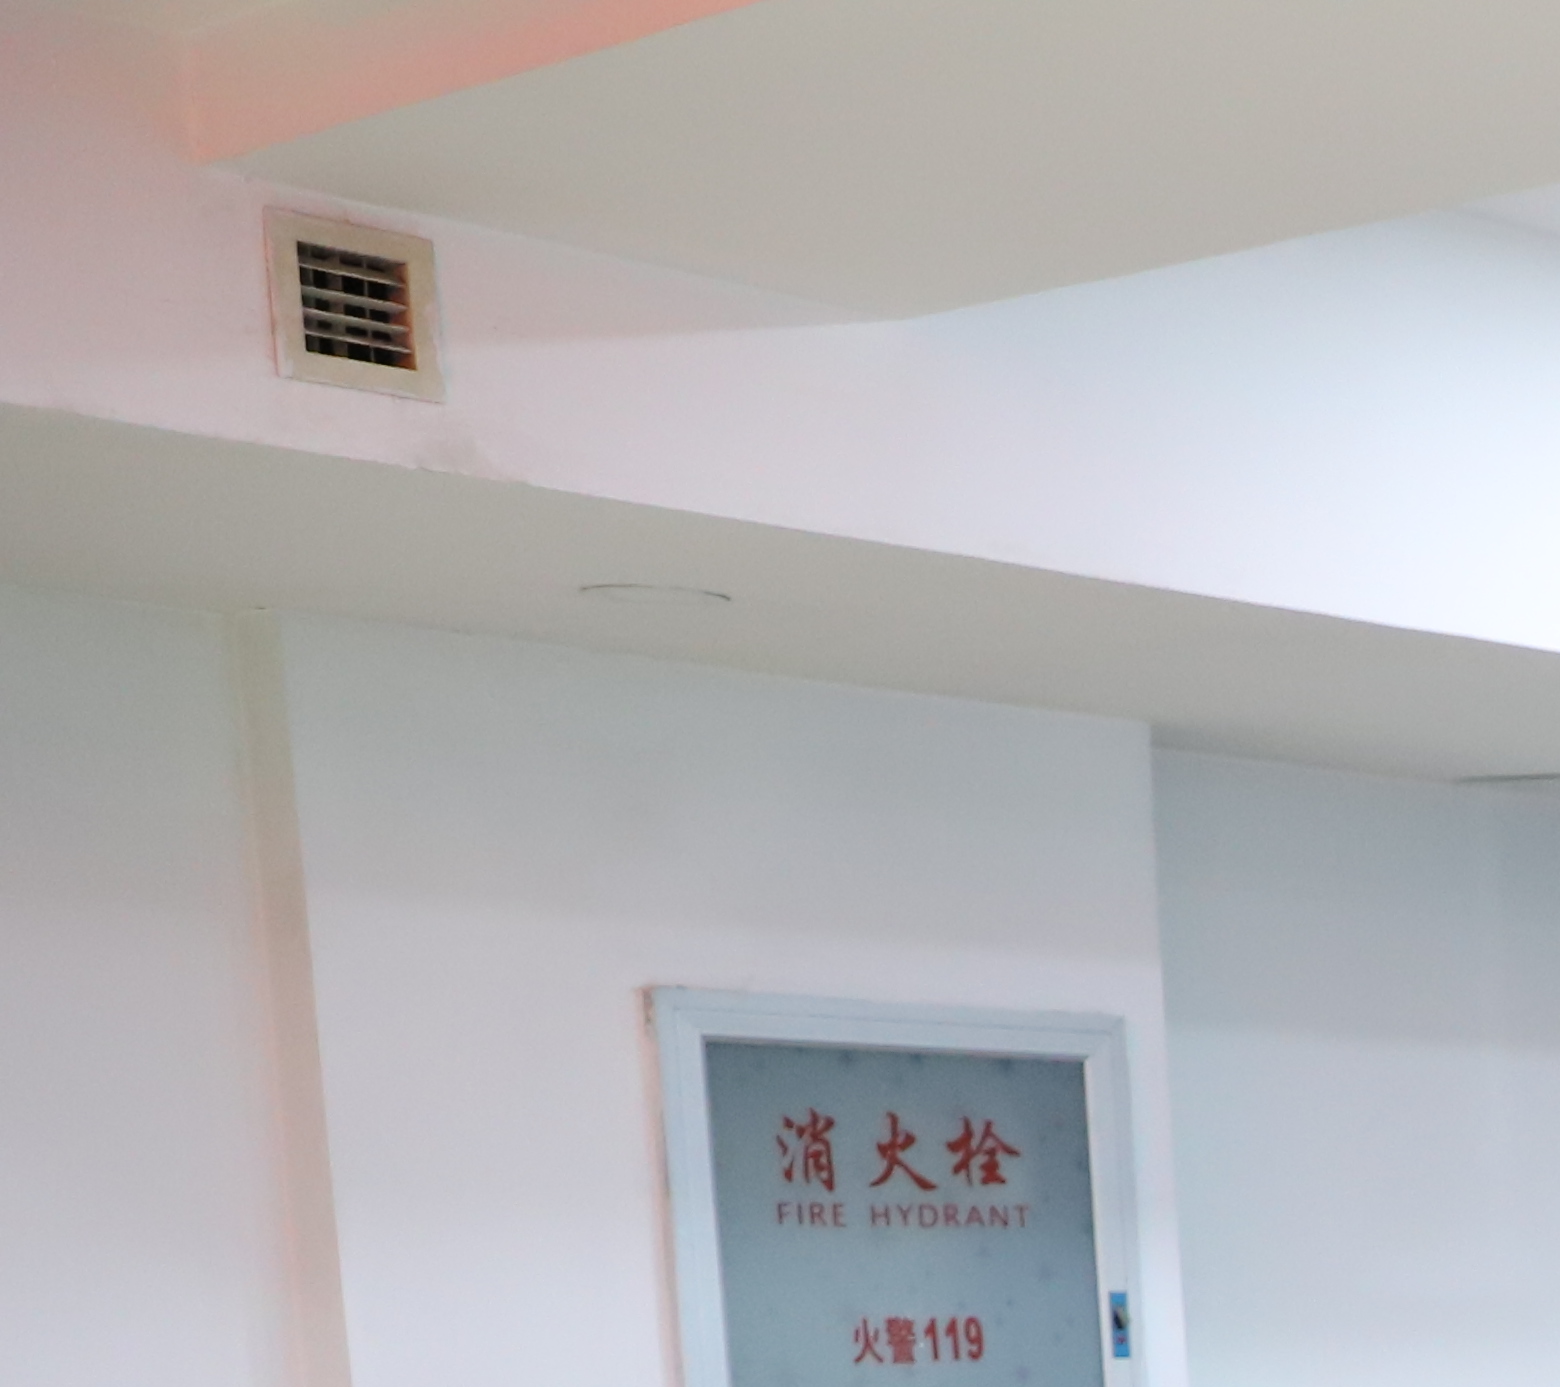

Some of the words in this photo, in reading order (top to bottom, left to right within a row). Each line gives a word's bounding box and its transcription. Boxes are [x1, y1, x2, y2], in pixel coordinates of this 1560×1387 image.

[776, 1107, 1021, 1193] 消火栓
[775, 1200, 846, 1228] FIRE
[869, 1200, 1031, 1229] HYDRANT
[852, 1315, 985, 1365] 火警119
